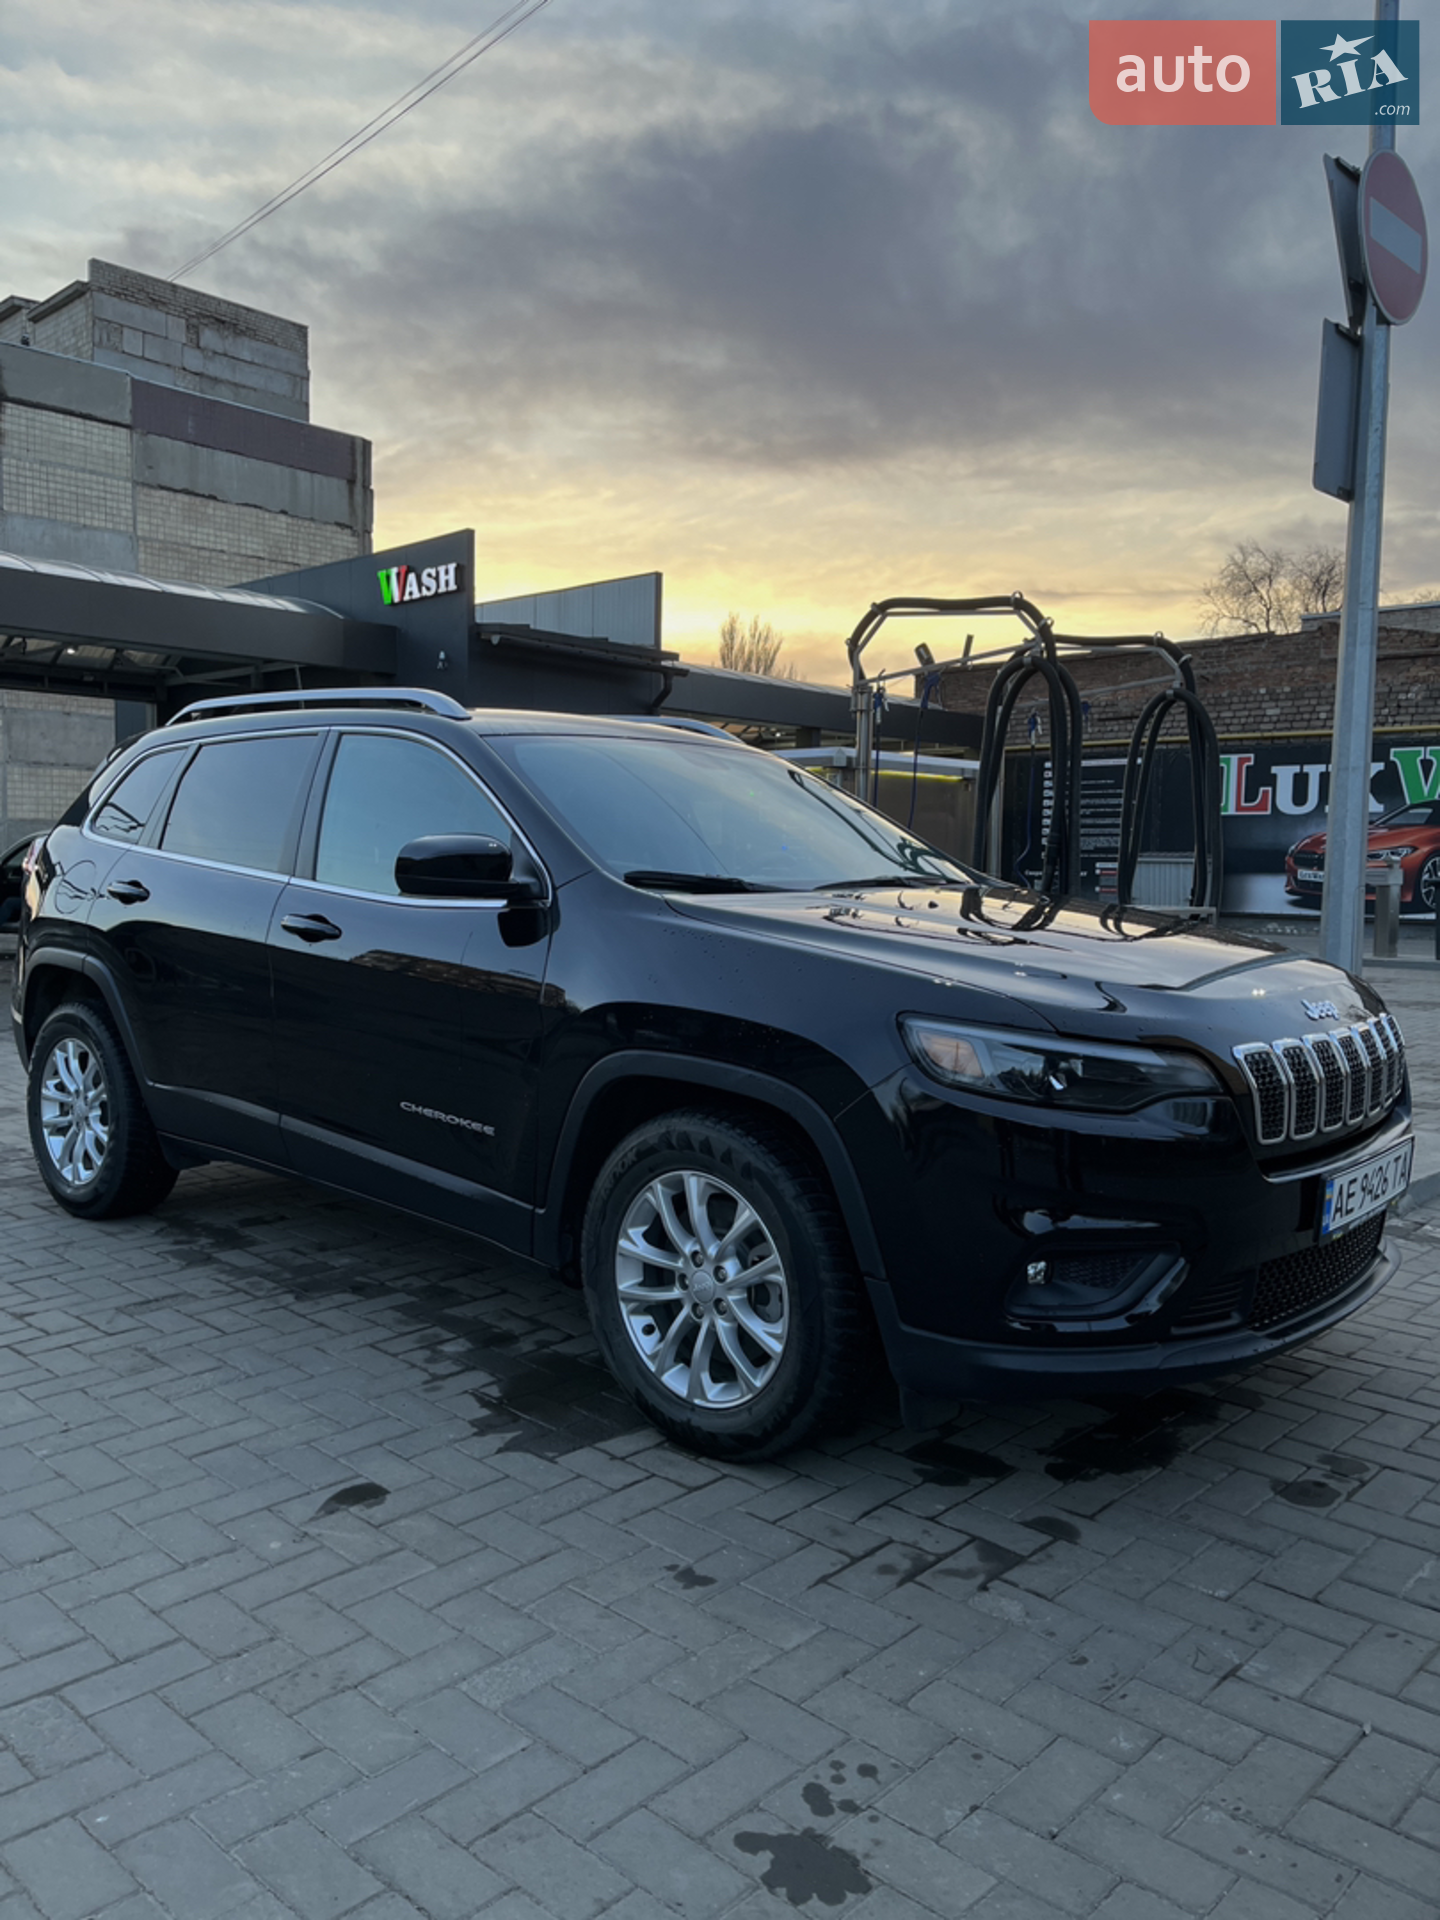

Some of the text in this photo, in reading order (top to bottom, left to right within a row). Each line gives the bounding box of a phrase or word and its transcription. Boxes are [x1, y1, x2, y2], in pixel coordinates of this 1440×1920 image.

[376, 562, 458, 605] WASH
[1302, 999, 1340, 1021] Jeep
[400, 1101, 495, 1136] CHEROKEE
[1332, 1176, 1358, 1222] AE
[1359, 1160, 1391, 1209] 9426
